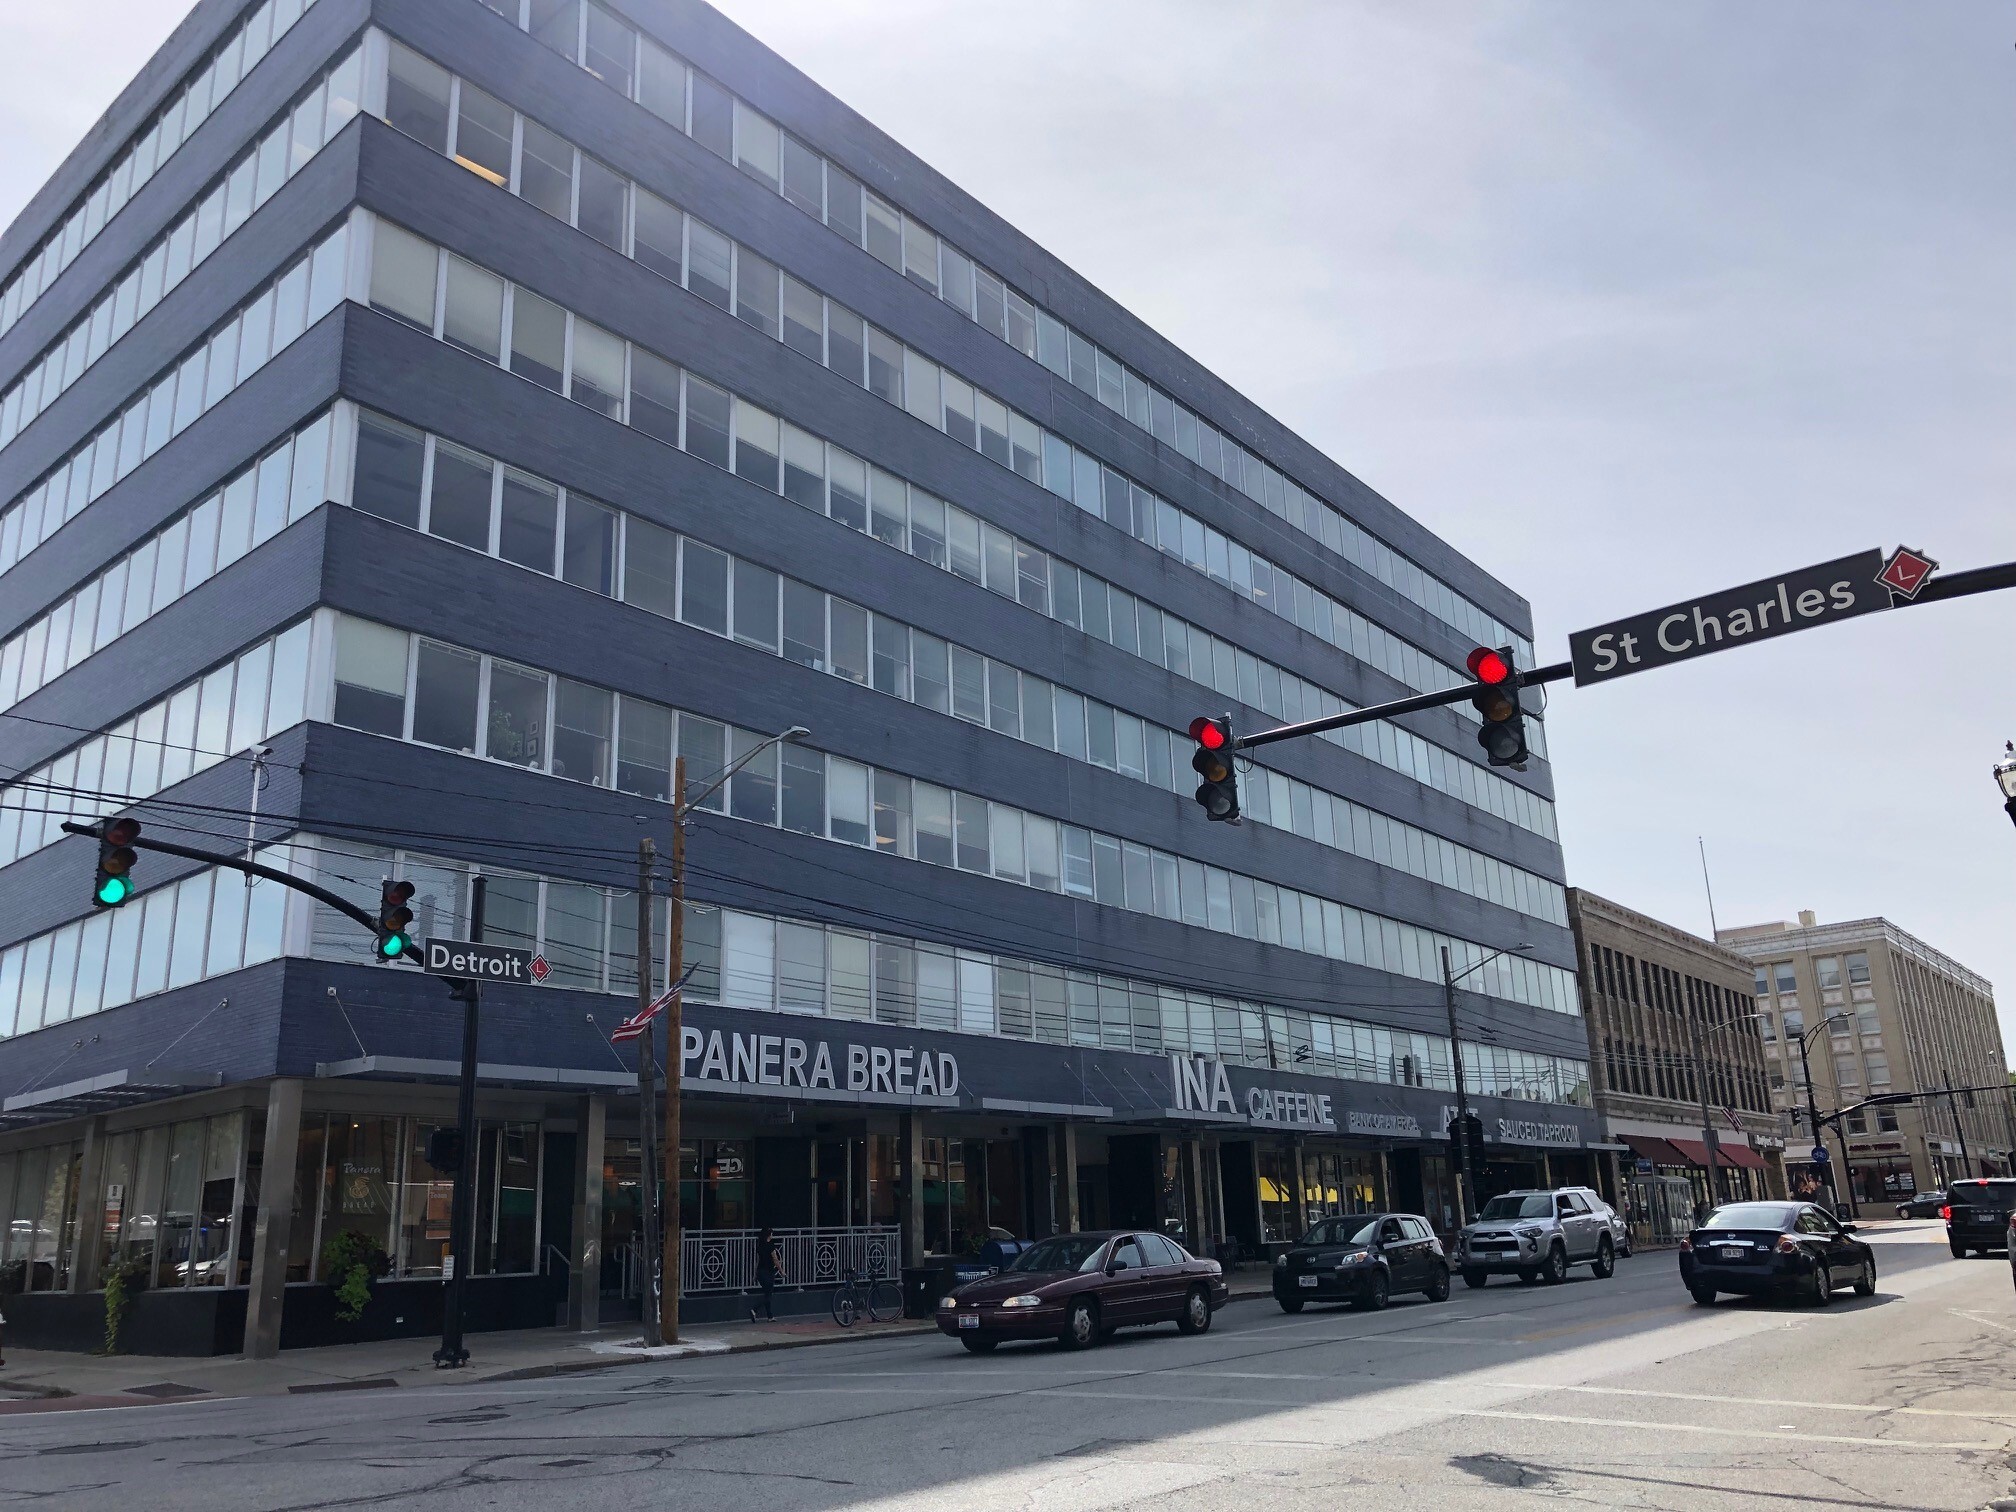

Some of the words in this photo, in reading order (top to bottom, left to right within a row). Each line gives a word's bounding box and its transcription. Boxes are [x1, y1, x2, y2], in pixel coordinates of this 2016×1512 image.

[1591, 632, 1641, 672] St
[1657, 579, 1856, 654] Charles
[431, 944, 522, 978] Detroit
[680, 1026, 836, 1090] PANERA
[847, 1043, 959, 1096] BREAD
[1169, 1054, 1238, 1114] INA
[1247, 1086, 1334, 1125] CAFFEINE
[1349, 1111, 1373, 1128] BANK
[1498, 1118, 1537, 1140] SAUCED
[1538, 1123, 1580, 1143] TAPROOM
[343, 1162, 381, 1174] Panera
